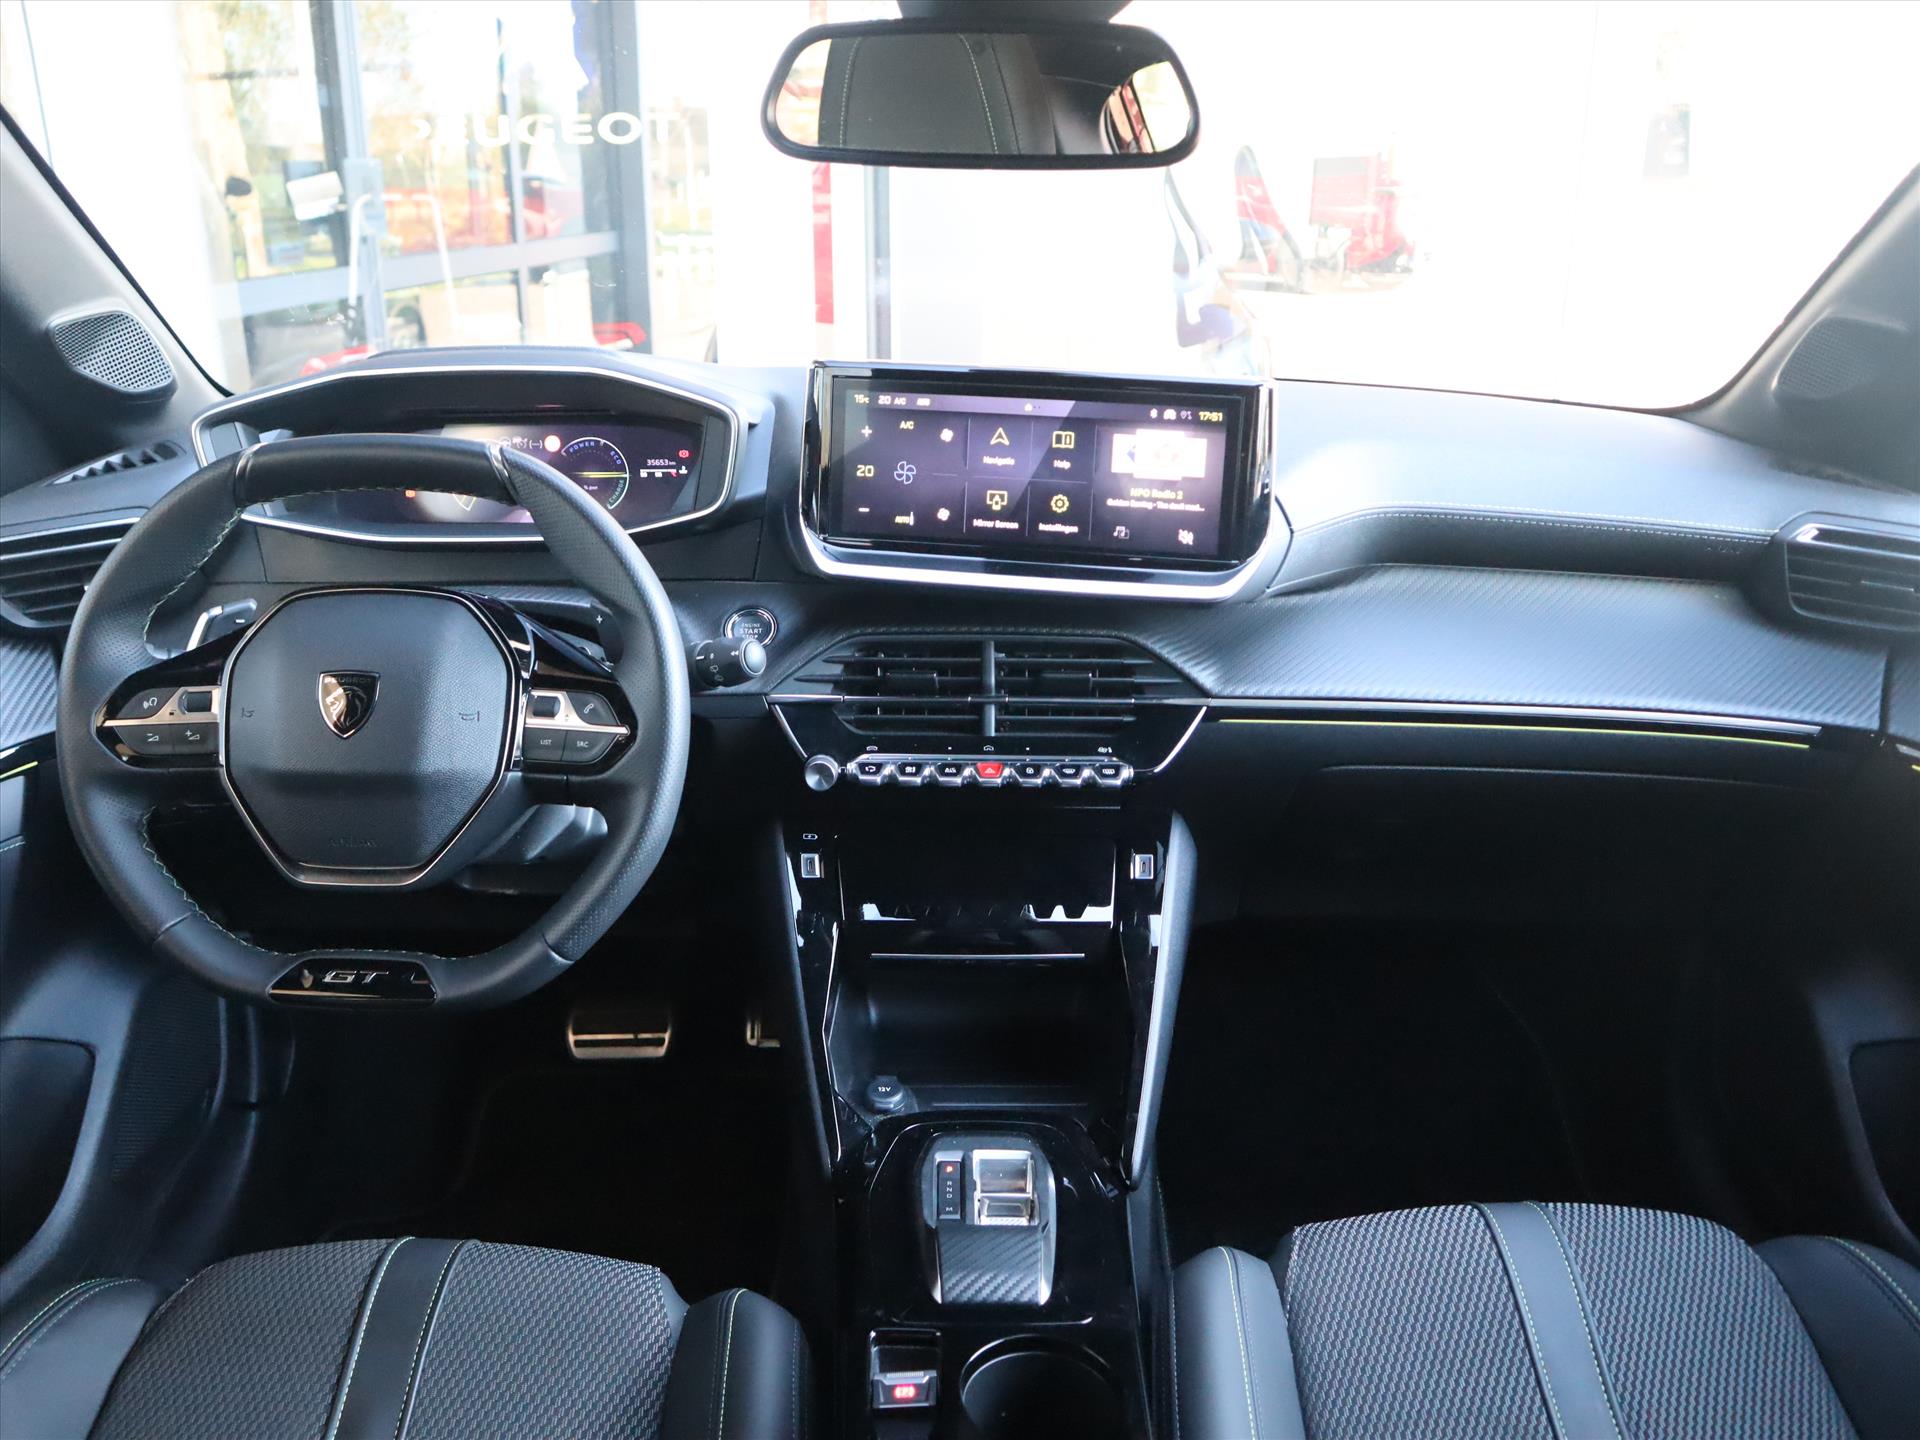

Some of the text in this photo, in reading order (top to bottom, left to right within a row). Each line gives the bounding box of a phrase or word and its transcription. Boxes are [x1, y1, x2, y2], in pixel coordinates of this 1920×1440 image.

[1199, 411, 1223, 422] 17:51
[900, 420, 915, 430] A/C
[569, 441, 595, 453] POWER
[610, 450, 622, 465] ECO
[646, 458, 669, 466] 35653
[856, 464, 875, 477] 20
[1151, 489, 1176, 500] Radio
[973, 518, 1019, 529] Mirror Screen
[576, 740, 589, 748] SRC
[322, 970, 389, 984] GT
